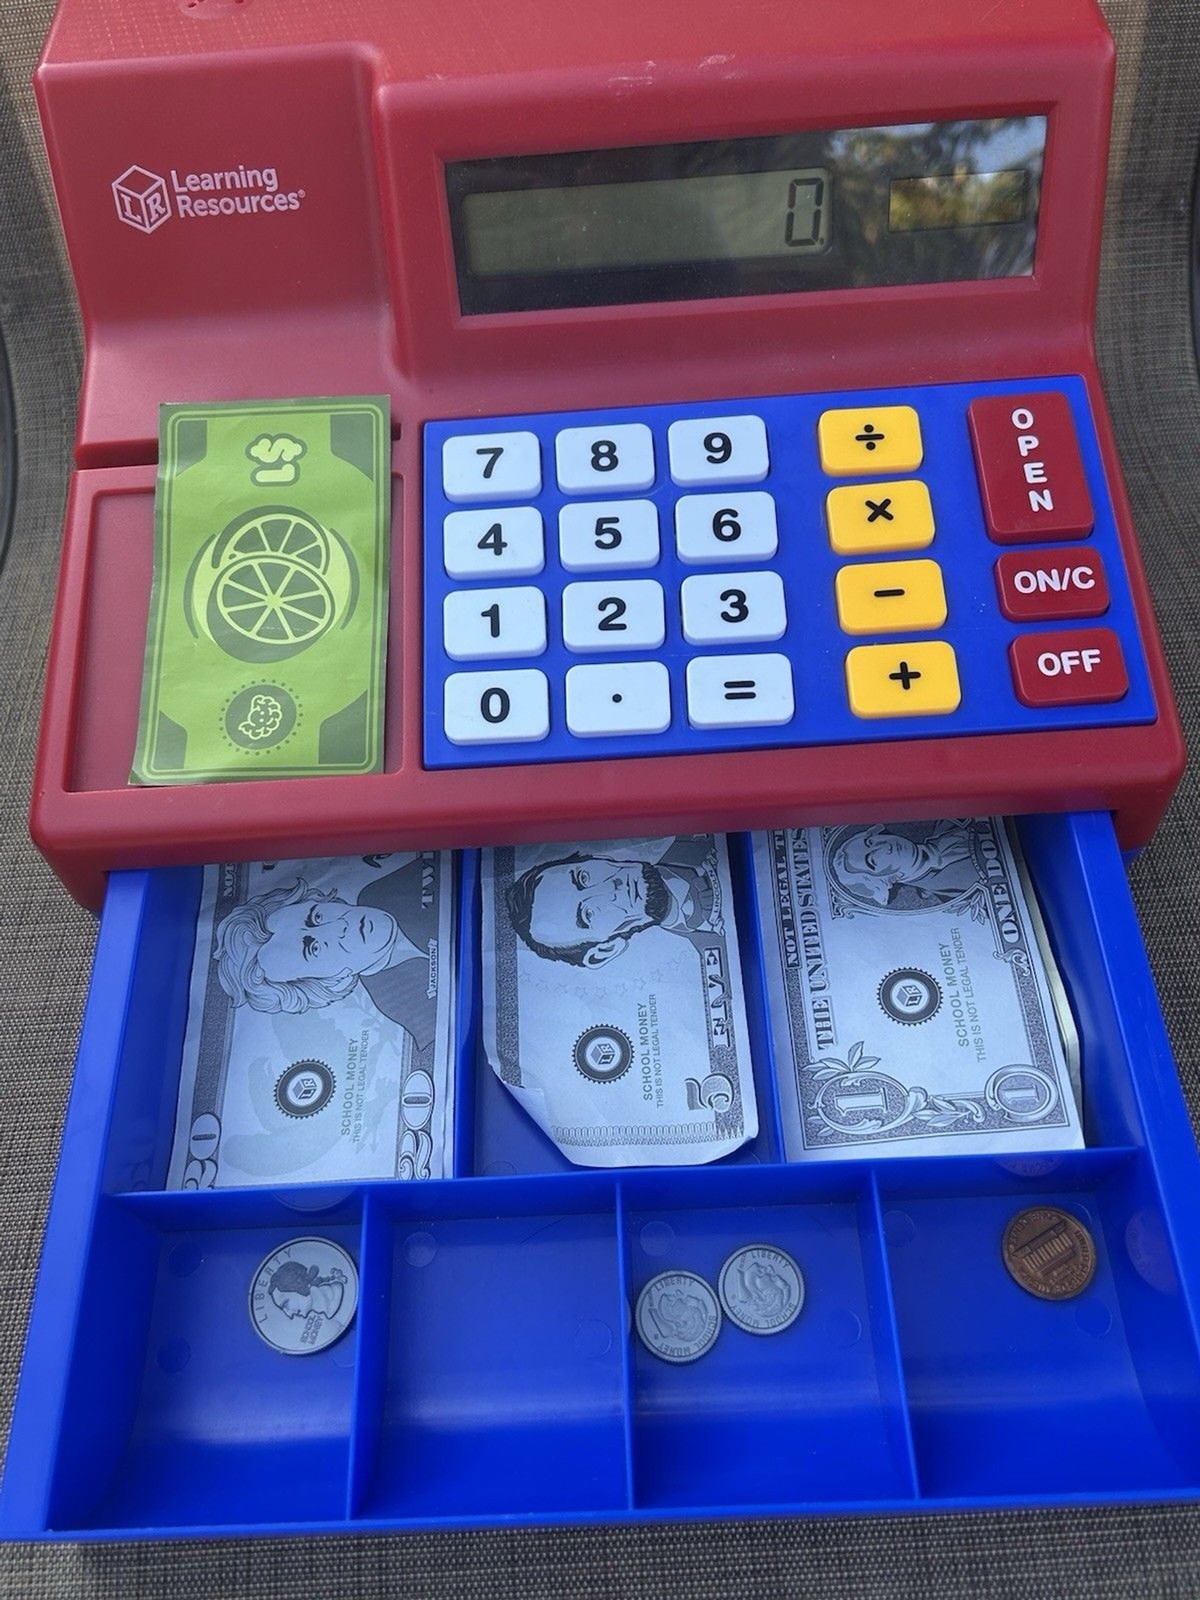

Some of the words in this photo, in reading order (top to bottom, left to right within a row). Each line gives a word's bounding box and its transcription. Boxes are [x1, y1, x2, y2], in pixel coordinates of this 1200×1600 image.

[171, 165, 278, 193] Learning
[476, 447, 504, 479] 7
[590, 440, 619, 472] 8
[703, 432, 733, 464] 9
[1011, 408, 1054, 513] OPEN
[477, 523, 508, 556] 4
[594, 517, 623, 550] 5
[712, 508, 742, 542] 6
[1013, 566, 1096, 594] ON/C
[481, 603, 501, 638] 1
[597, 597, 627, 631] 2
[719, 589, 749, 623] 3
[1037, 648, 1101, 677] OFF
[480, 687, 511, 723] 0
[974, 817, 1005, 879] DOL
[791, 828, 816, 908] STATES
[708, 869, 721, 913] LINCOLN
[777, 856, 793, 921] LEGAL
[991, 884, 1020, 943] ONE
[784, 927, 799, 967] NOT
[800, 910, 830, 994] UNITED
[949, 927, 966, 964] TENDER
[939, 942, 958, 986] MONEY
[705, 948, 732, 1048] FIVE
[959, 966, 974, 998] LEGAL
[637, 1002, 649, 1045] MONEY
[648, 993, 659, 1027] TENDER
[812, 998, 836, 1050] THE
[949, 991, 969, 1047] SCHOOL
[966, 1001, 979, 1022] NOT
[360, 1029, 369, 1062] TENDER
[651, 1028, 660, 1056] LEGAL
[972, 1024, 982, 1035] IS
[345, 1038, 358, 1080] MONEY
[973, 1037, 987, 1063] THIS
[357, 1064, 367, 1091] LEGAL
[641, 1050, 653, 1101] SCHOOL
[653, 1058, 662, 1076] NOT
[654, 1077, 663, 1086] IS
[356, 1093, 364, 1110] NOT
[655, 1088, 664, 1108] THIS
[684, 1073, 735, 1113] 5
[835, 1087, 889, 1117] 1
[1000, 1085, 1040, 1105] 1
[341, 1085, 354, 1135] SCHOOL
[354, 1112, 363, 1121] IS
[352, 1123, 362, 1143] THIS
[752, 1250, 791, 1269] LIBERTY
[255, 1248, 293, 1323] LIBERTY
[654, 1276, 694, 1293] LIBERTY
